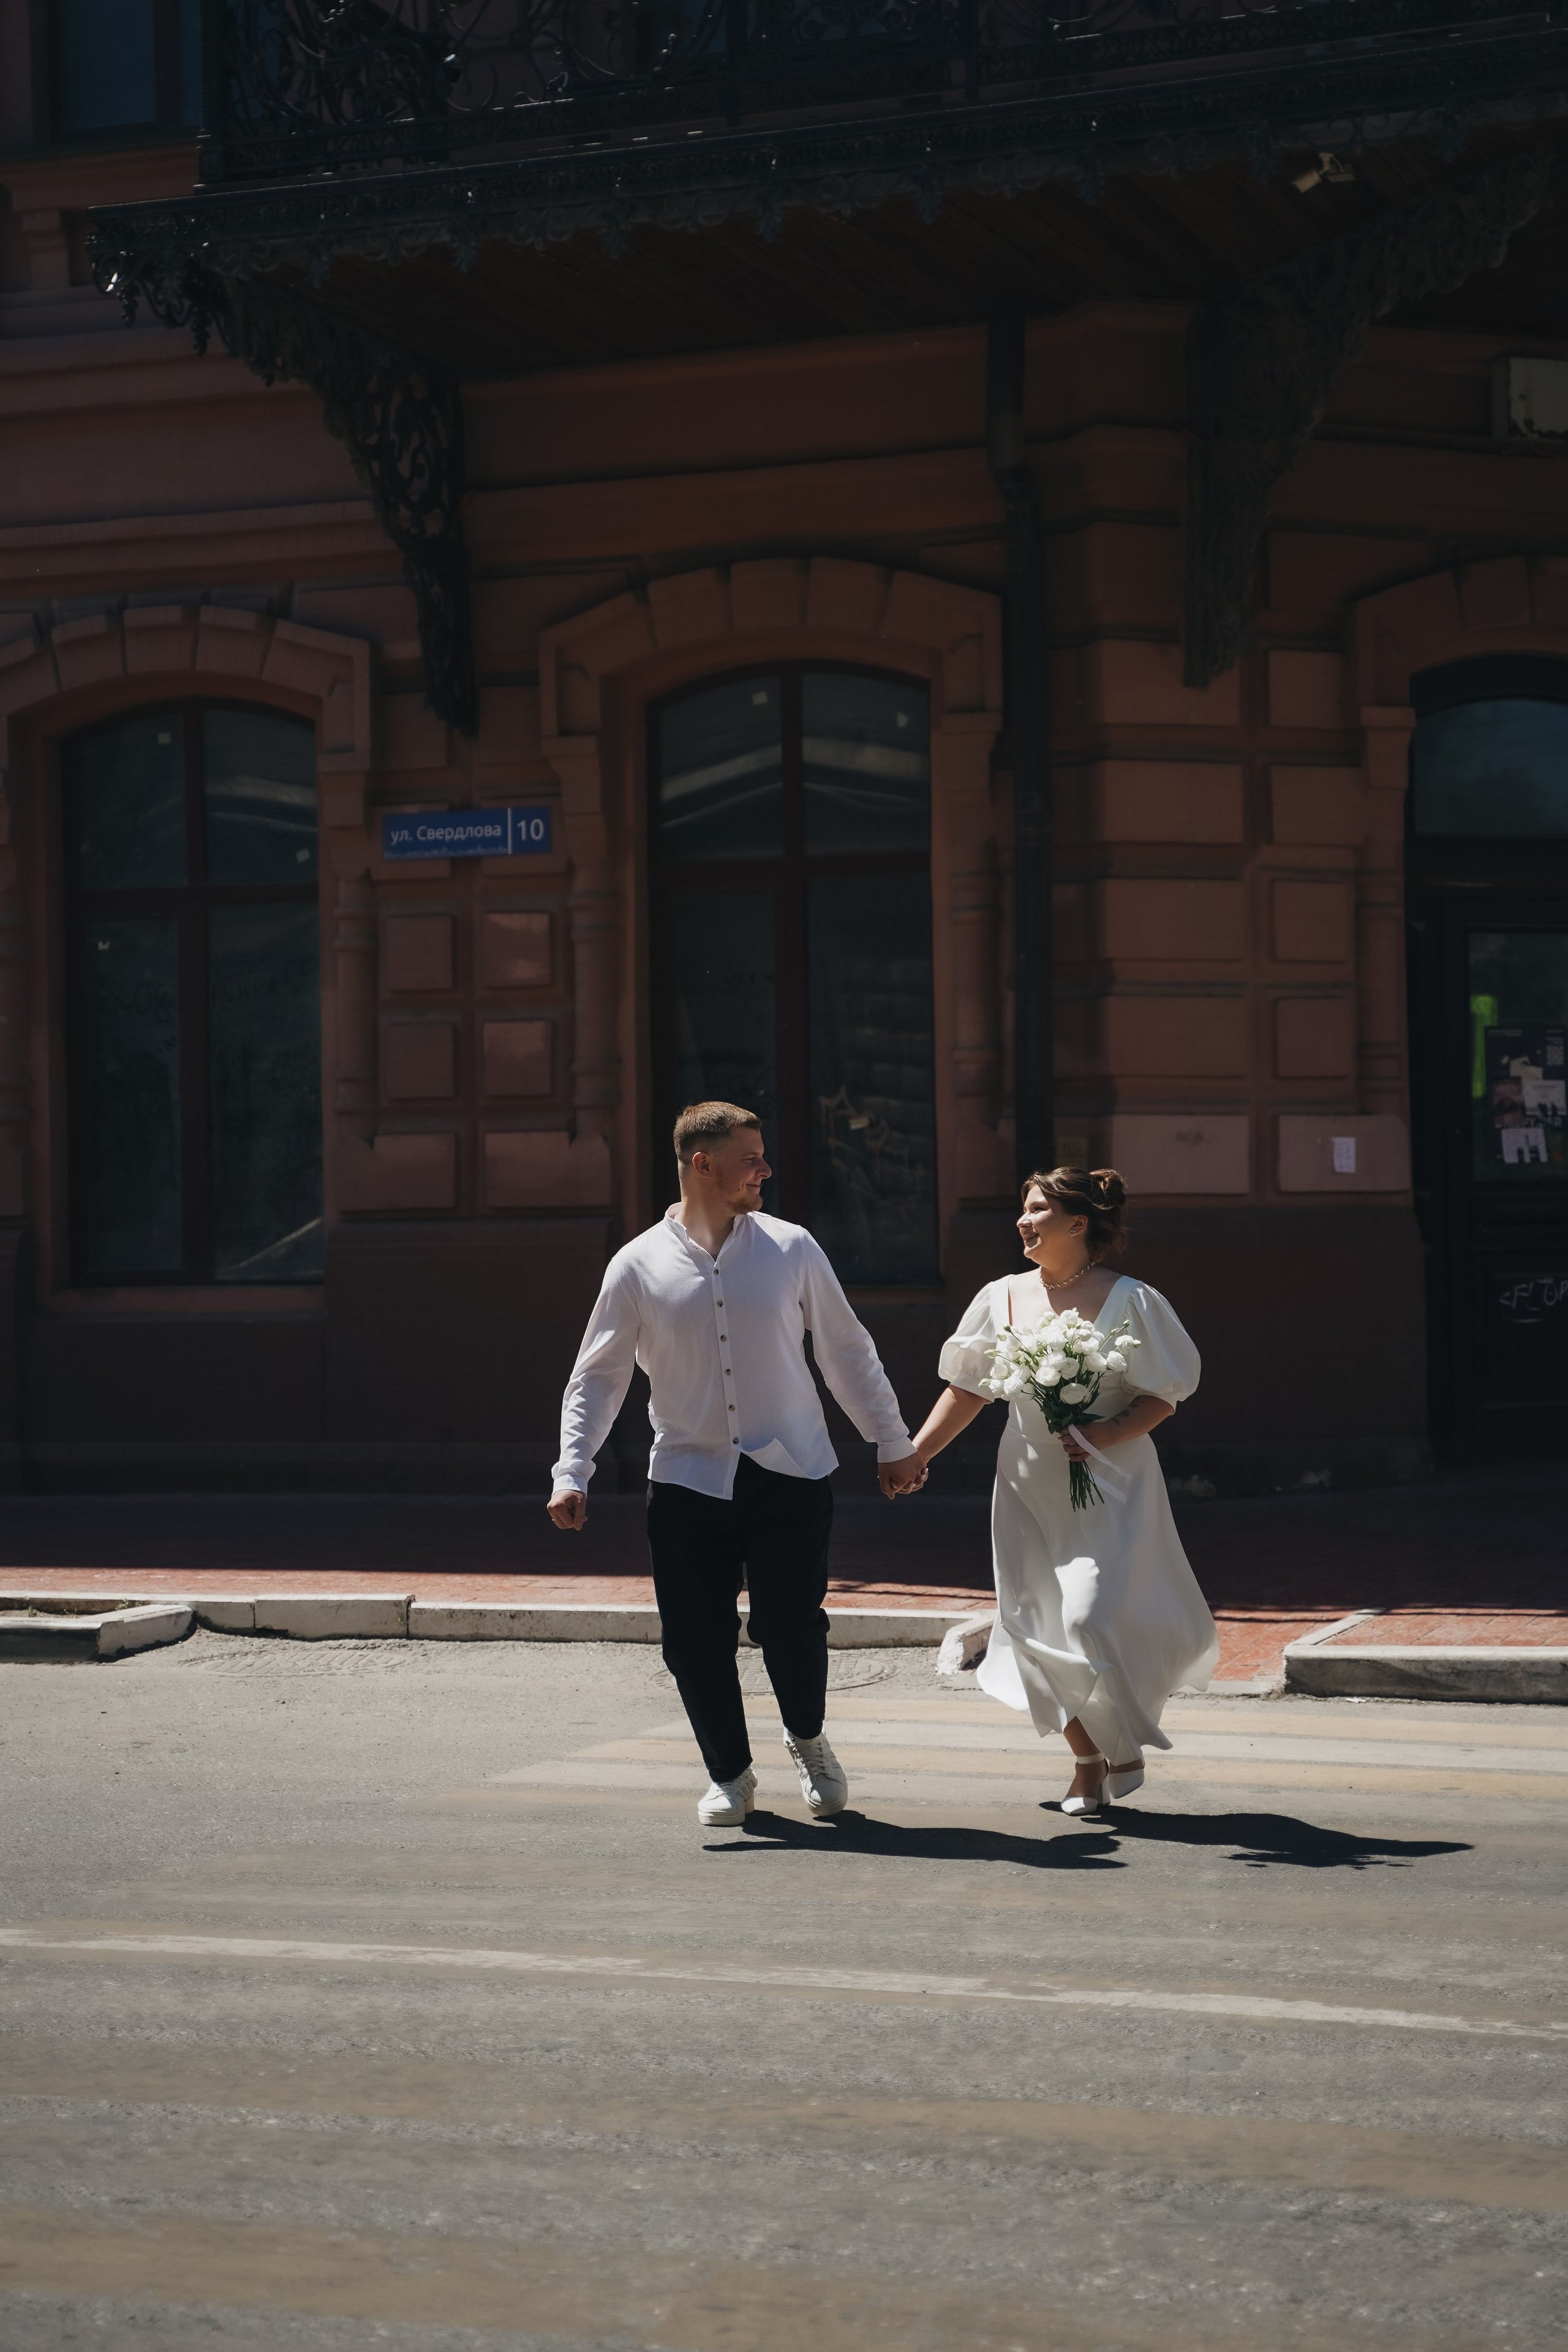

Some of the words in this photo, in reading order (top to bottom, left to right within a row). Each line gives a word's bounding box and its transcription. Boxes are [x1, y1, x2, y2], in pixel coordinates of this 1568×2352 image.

[390, 830, 412, 845] ул.
[417, 824, 502, 842] Свердлова
[517, 818, 544, 840] 10
